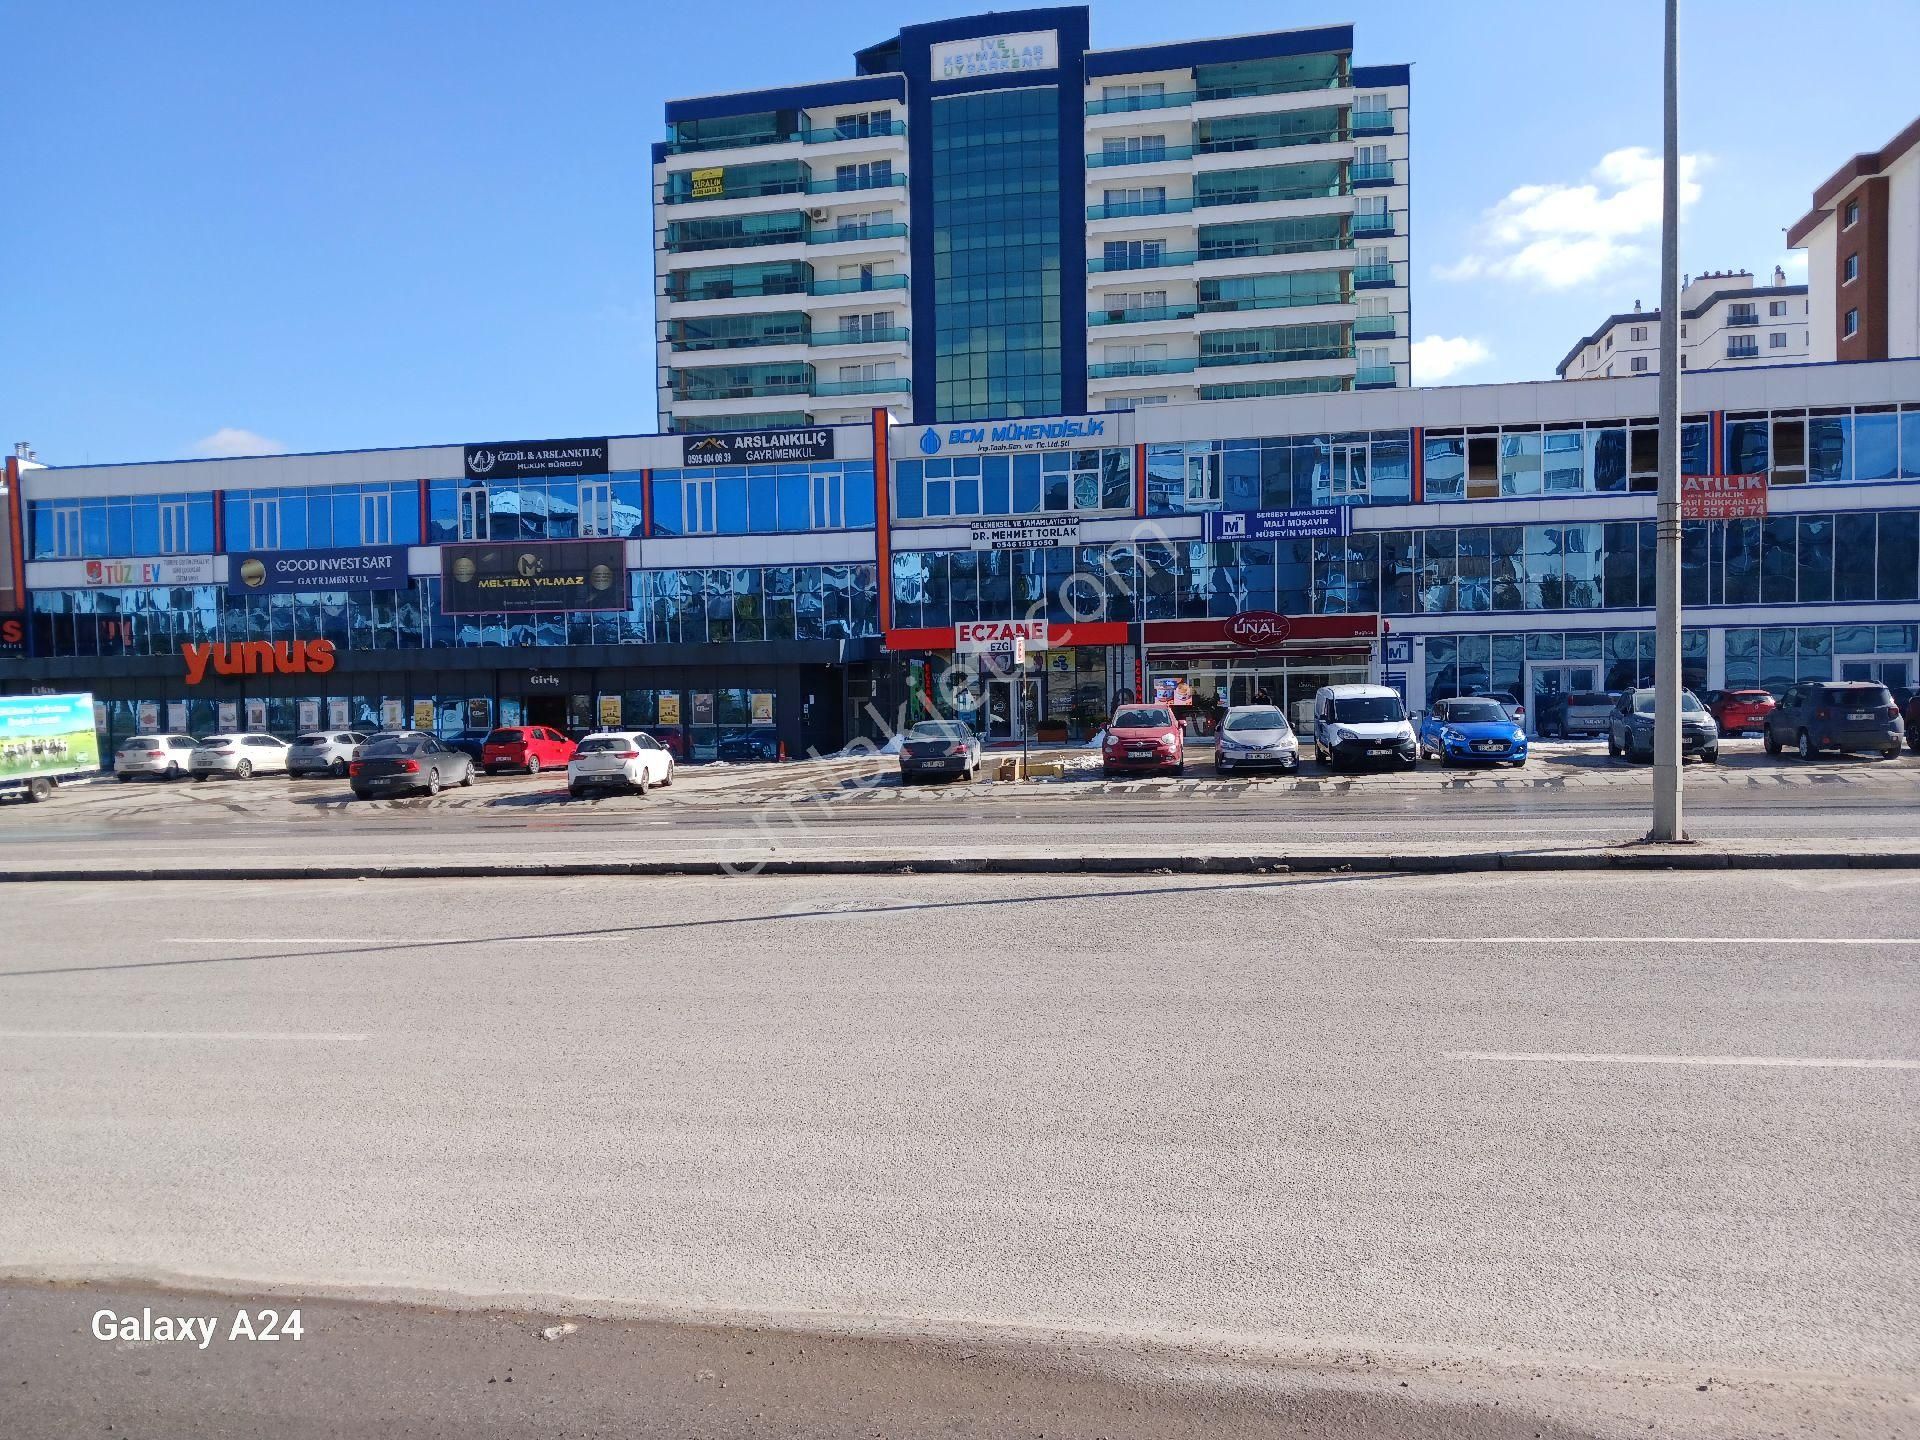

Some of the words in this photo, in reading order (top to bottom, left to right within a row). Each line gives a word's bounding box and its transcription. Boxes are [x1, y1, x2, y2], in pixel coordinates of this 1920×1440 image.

[949, 428, 985, 444] BCM
[991, 417, 1105, 442] MÜHENDİSLİK
[734, 431, 827, 448] ARSLANKILIÇ
[497, 450, 527, 461] ÖZDİL
[527, 451, 535, 460] &
[745, 447, 816, 461] GAYRİMENKUL
[1681, 476, 1763, 490] ATILIK
[1683, 507, 1699, 517] 32
[1703, 507, 1725, 517] 351
[1729, 506, 1745, 516] 36
[1748, 505, 1765, 515] 74
[972, 531, 990, 540] DR.
[991, 529, 1034, 540] MEHMET
[1036, 527, 1077, 538] TORLAK
[275, 559, 318, 572] GOOD
[319, 557, 361, 571] INVEST
[362, 555, 393, 569] SART
[477, 578, 531, 588] MELTEM
[533, 576, 584, 587] YILMAZ
[959, 622, 1044, 642] ECZANE
[181, 640, 336, 685] yunus
